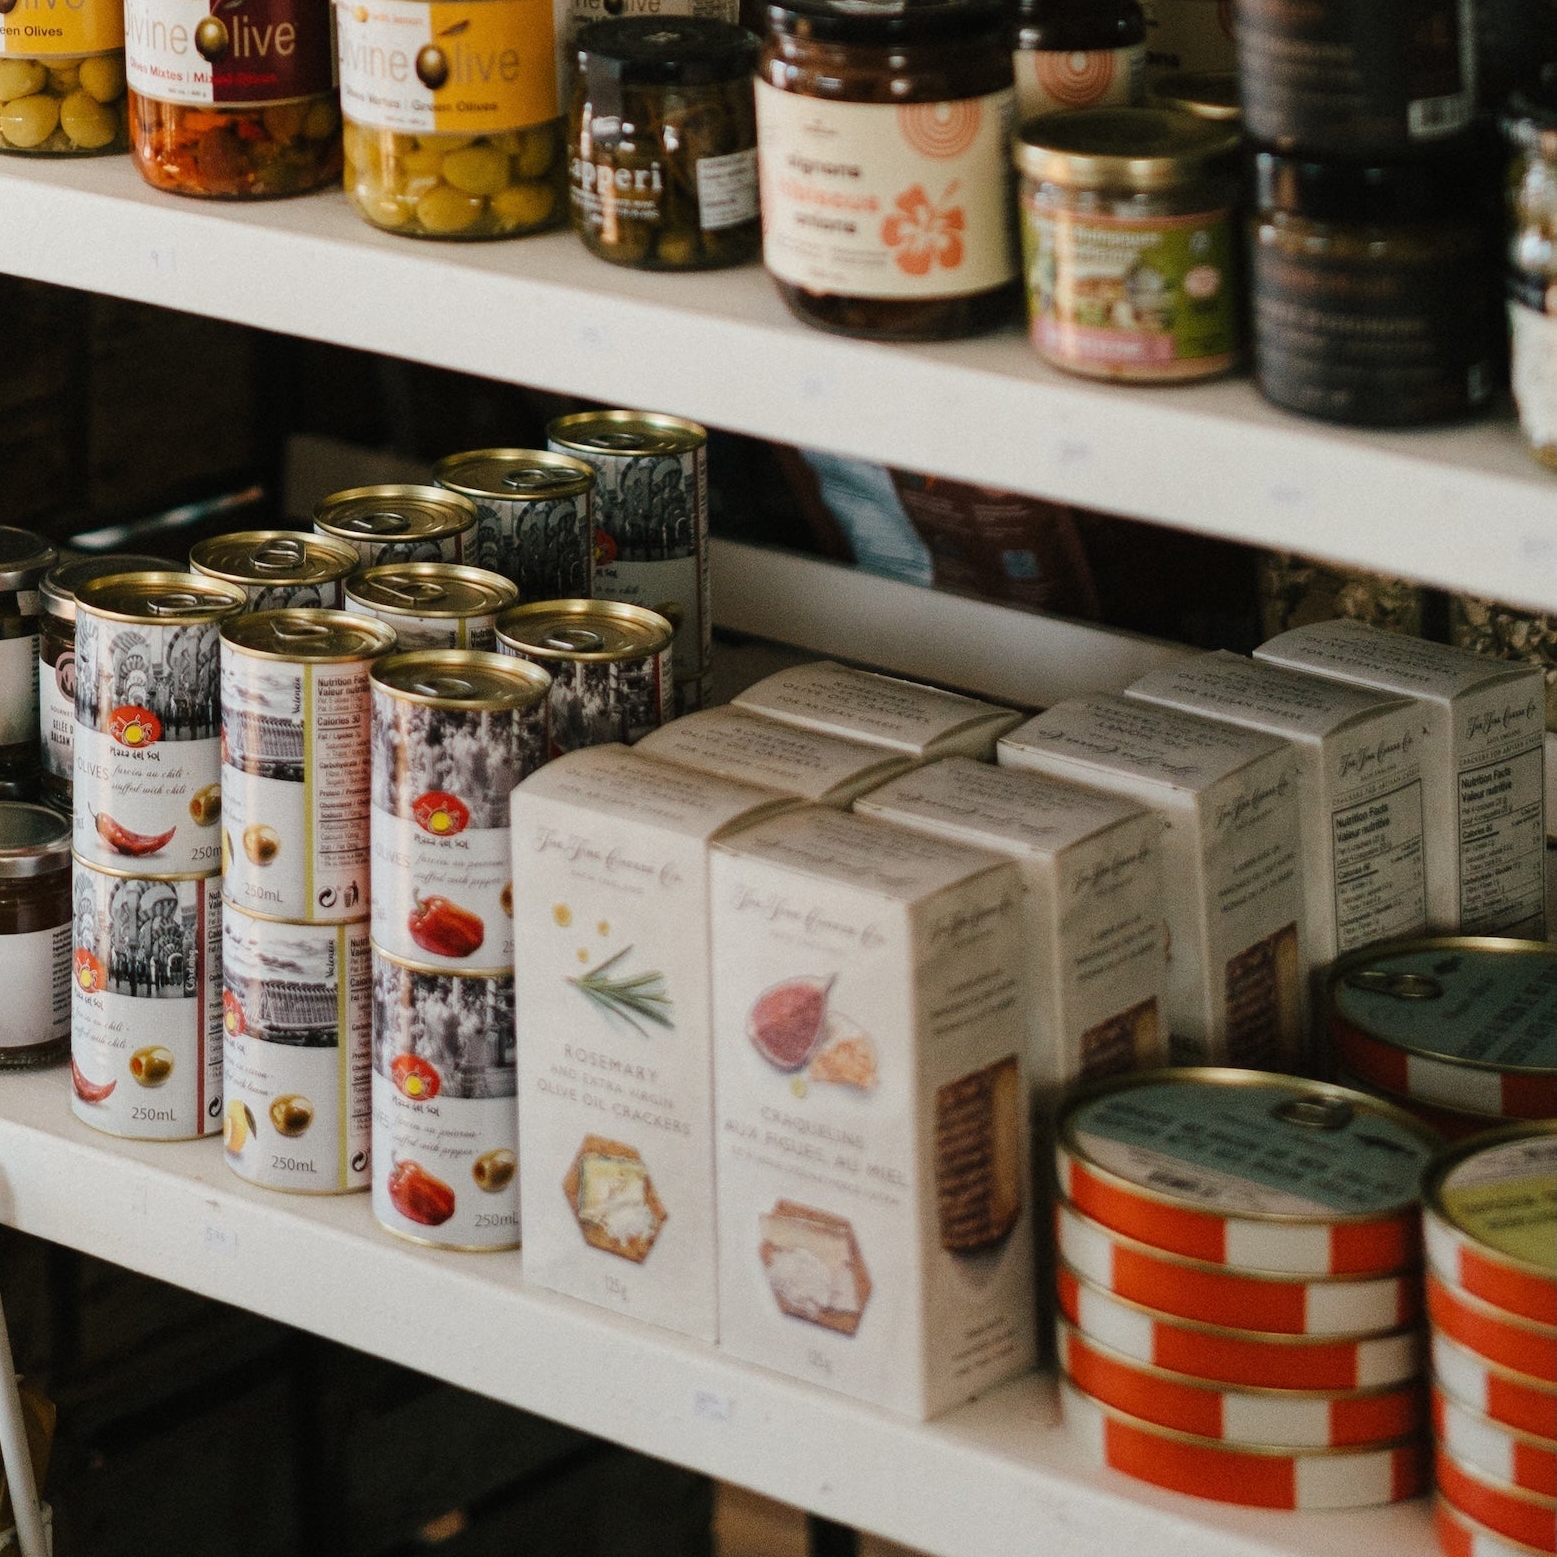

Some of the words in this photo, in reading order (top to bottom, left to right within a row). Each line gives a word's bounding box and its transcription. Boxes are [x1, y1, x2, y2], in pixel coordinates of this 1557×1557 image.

[24, 24, 63, 36] Olives
[149, 65, 183, 81] Mixtes
[318, 676, 350, 687] Nutrition
[317, 687, 341, 696] Valeur
[53, 719, 68, 732] GELÉE
[317, 715, 350, 726] Calories
[51, 732, 70, 746] BALSAM
[147, 749, 161, 762] Sol
[77, 756, 109, 781] OLIVES
[1461, 771, 1491, 790] Nutrition
[1493, 766, 1511, 780] Facts
[1461, 787, 1484, 802] Valeur
[1336, 808, 1367, 829] Nutrition
[1369, 802, 1388, 818] Facts
[1336, 824, 1360, 843] Valeur
[243, 882, 284, 903] 250mL
[564, 1044, 658, 1081] ROSEMARY
[581, 1071, 623, 1095] EXTRA
[131, 1106, 177, 1122] 250mL
[536, 1077, 577, 1102] OLIVE
[582, 1093, 605, 1113] OIL
[611, 1102, 691, 1136] CRACKERS
[271, 1156, 317, 1173] 250mL
[474, 1213, 519, 1227] 250mL
